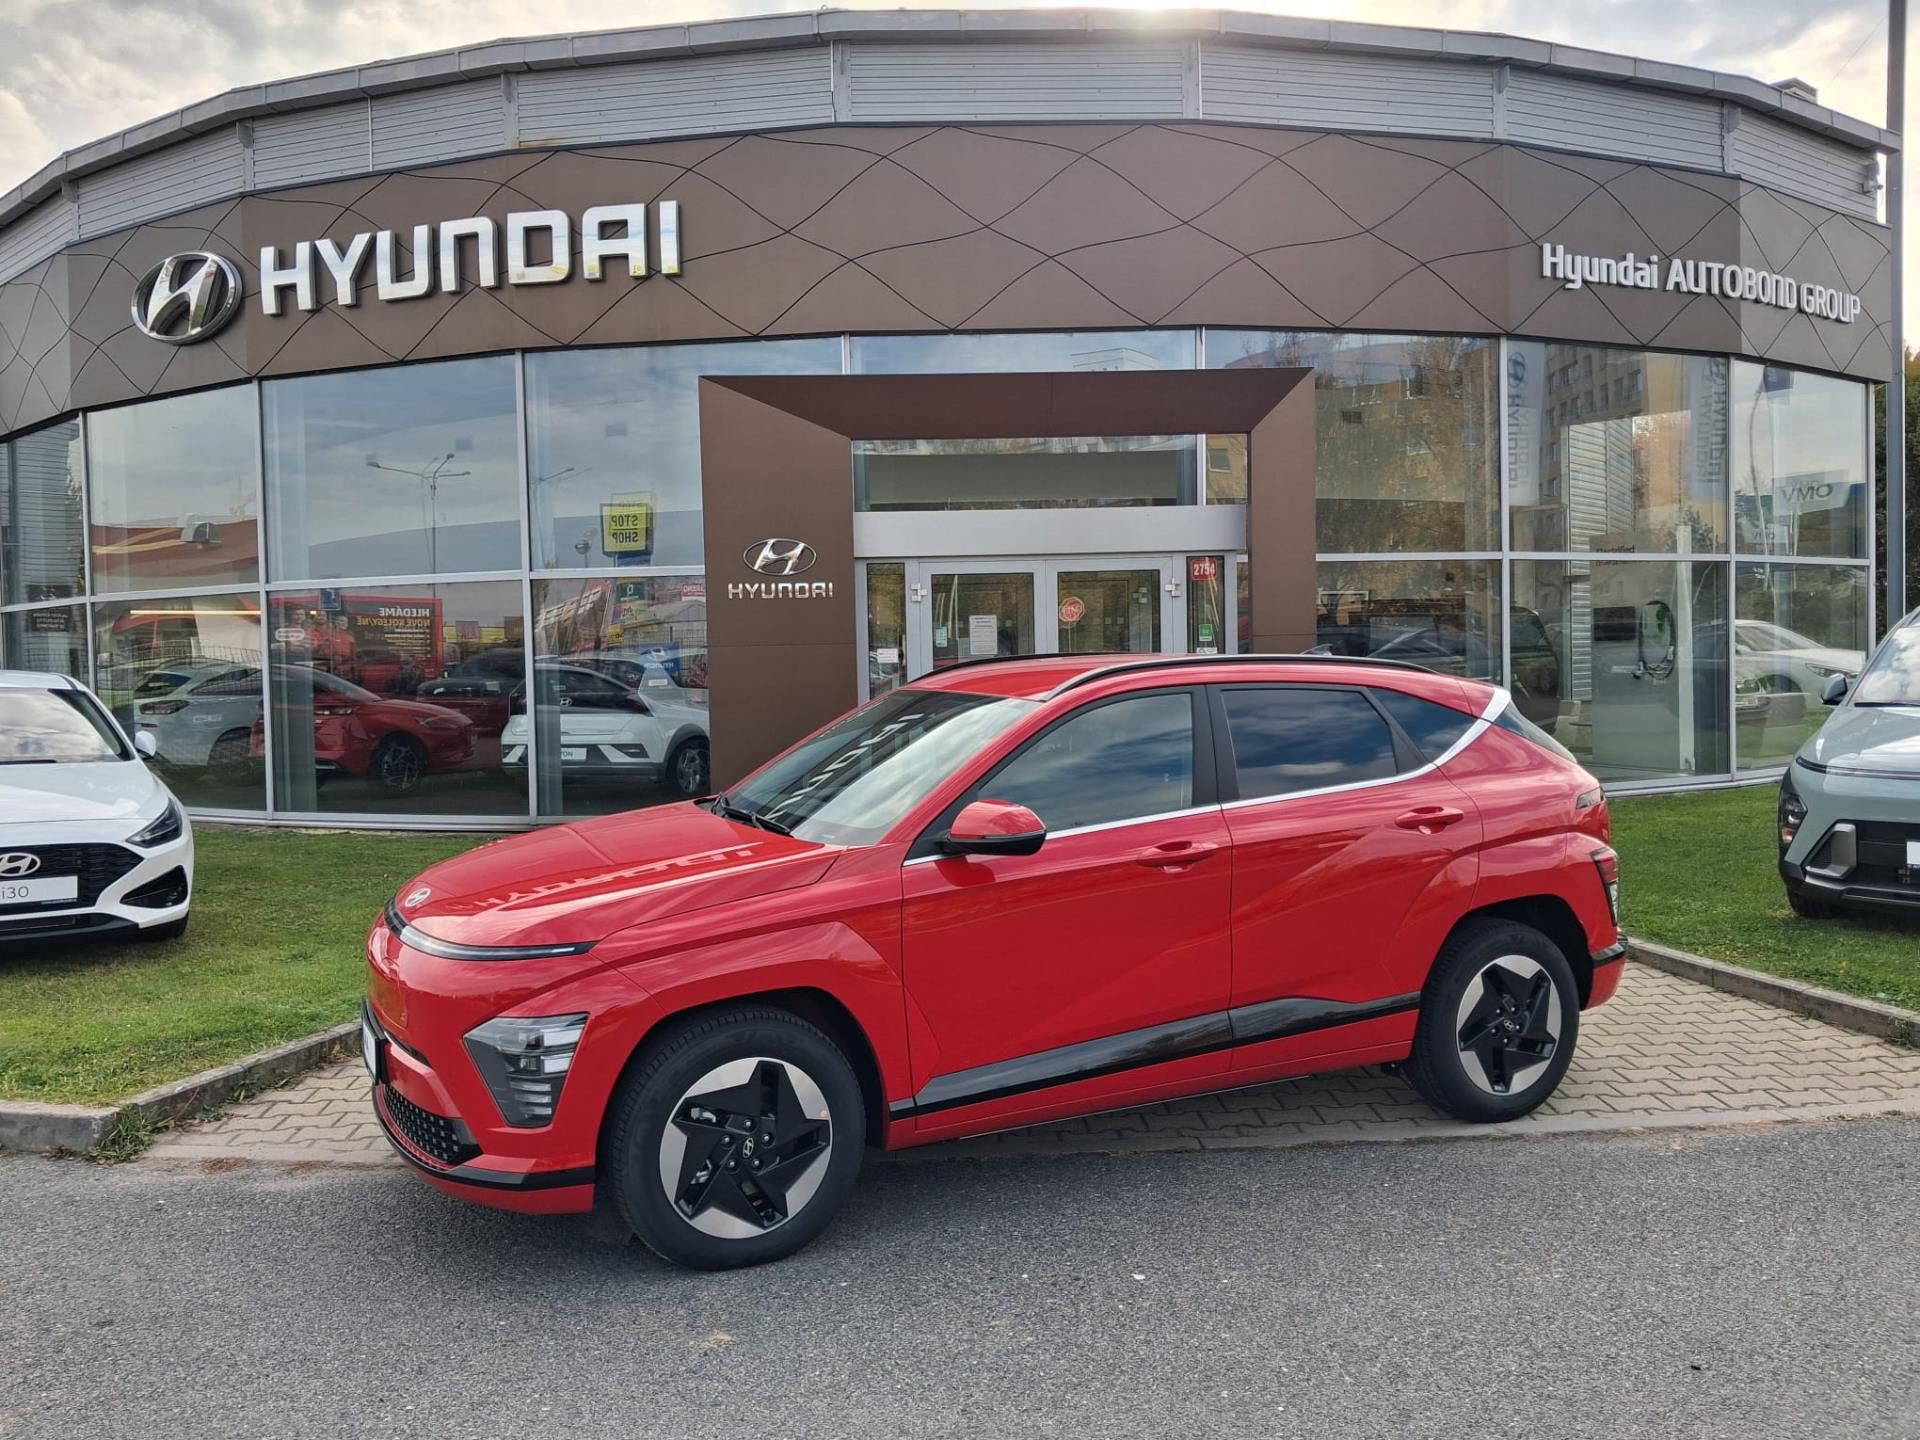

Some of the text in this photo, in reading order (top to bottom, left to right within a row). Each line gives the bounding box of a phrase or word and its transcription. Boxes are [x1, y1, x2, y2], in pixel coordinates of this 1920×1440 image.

[260, 200, 681, 315] HYUNDAI
[1542, 243, 1861, 323] Hyundai AUTOBOND GROUP
[727, 582, 833, 600] HYUNDAI
[1, 886, 29, 899] i30
